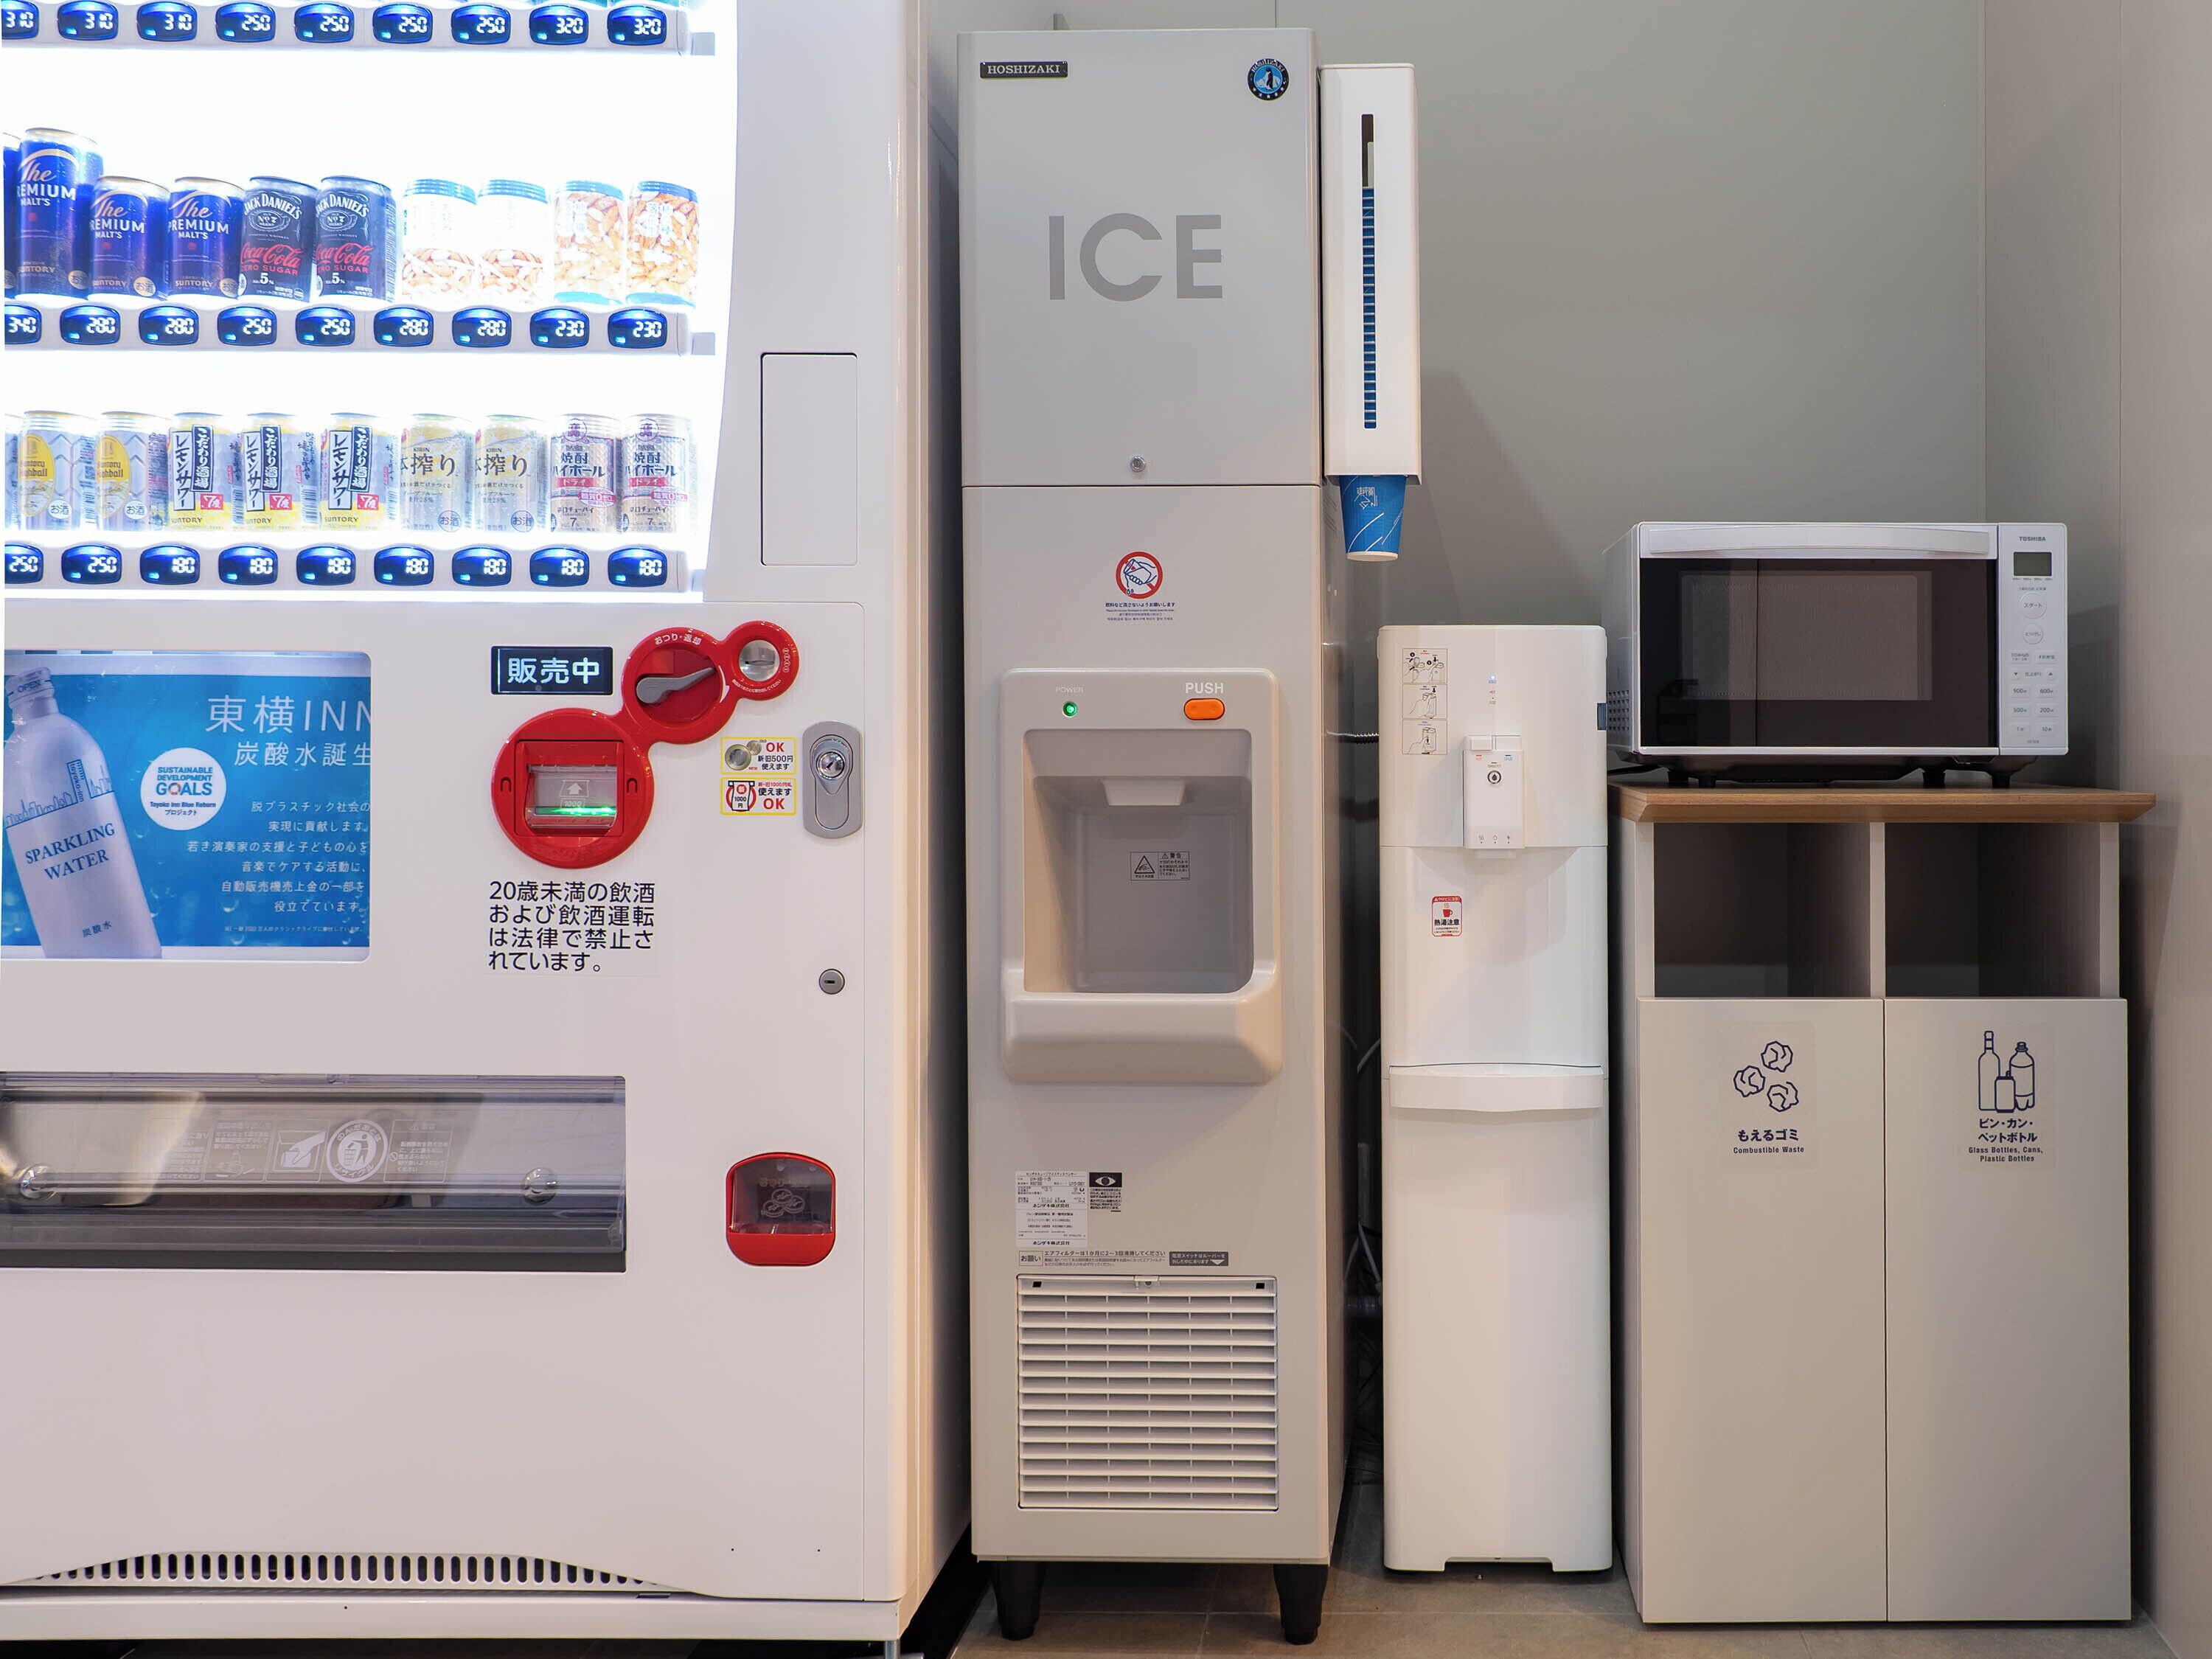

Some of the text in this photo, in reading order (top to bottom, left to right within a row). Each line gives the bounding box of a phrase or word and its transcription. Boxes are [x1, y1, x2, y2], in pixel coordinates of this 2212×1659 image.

[6, 12, 33, 28] 310
[86, 13, 113, 29] 310
[165, 14, 192, 30] 310
[242, 14, 271, 31] 250
[321, 15, 349, 32] 250
[399, 16, 427, 32] 250
[476, 16, 505, 33] 250
[556, 16, 583, 34] 320
[634, 17, 661, 35] 320
[987, 64, 1061, 74] HOSHIZAKI
[20, 159, 57, 183] The
[94, 198, 128, 218] The
[175, 198, 212, 218] The
[244, 193, 302, 220] JACK DANIEL'S
[330, 193, 369, 218] DANIEL'S
[178, 232, 209, 240] MALT'S
[1049, 212, 1223, 302] ICE
[262, 265, 299, 276] SUGAR
[334, 265, 369, 274] SUGAR
[9, 317, 36, 333] 340
[87, 317, 115, 334] 280
[165, 318, 194, 335] 280
[243, 318, 271, 335] 250
[321, 319, 350, 335] 250
[400, 319, 428, 335] 280
[477, 319, 506, 336] 280
[555, 320, 585, 337] 230
[633, 320, 661, 337] 230
[195, 428, 211, 488] こだわり酒場
[263, 428, 279, 489] こだわり酒場
[352, 428, 369, 488] こだわり酒場
[562, 452, 588, 464] 焼酎
[635, 452, 661, 464] 焼酎
[175, 434, 192, 507] レモンサワー
[246, 435, 262, 507] レモンサワー
[333, 434, 349, 507] レモンサワー
[553, 465, 605, 478] ハイボール
[51, 503, 69, 515] お酒
[126, 503, 145, 515] お酒
[440, 517, 459, 526] お酒
[513, 517, 532, 526] お酒
[9, 556, 38, 572] 250
[87, 557, 116, 574] 250
[172, 557, 195, 574] 180
[250, 557, 273, 574] 180
[327, 557, 351, 574] 180
[406, 557, 428, 574] 180
[484, 558, 507, 575] 180
[561, 559, 584, 575] 180
[639, 559, 662, 576] 180
[655, 633, 702, 645] おつり・返却
[507, 658, 599, 684] 販売中
[18, 680, 41, 693] OPEN
[1185, 682, 1224, 695] PUSH
[234, 740, 371, 766] 炭酸水誕生
[766, 742, 785, 752] OK
[156, 782, 212, 796] GOALS
[758, 787, 792, 796] 使えます
[251, 801, 370, 812] 脱プラスチック社会の
[763, 798, 785, 810] OK
[268, 821, 368, 832] 実現に貢献します。
[25, 822, 116, 864] SPARKLING
[187, 841, 367, 854] 若き演奏家の支援と子どもの心を
[44, 849, 109, 880] WATER
[242, 861, 366, 873] 音楽でケアする活動に、
[222, 880, 364, 892] 自動販売機売上金の一部を
[489, 880, 655, 903] 20歳未満の飲酒
[274, 901, 365, 913] 役立てています。
[490, 904, 655, 927] および飲酒運転
[83, 921, 112, 938] 炭酸水
[490, 927, 653, 950] は法律で禁止さ
[488, 950, 601, 973] れています。
[337, 1121, 382, 1141] のんだあとは
[1979, 1119, 2033, 1129] ビン・カン・
[1738, 1129, 1798, 1141] もえるゴミ
[1978, 1132, 2037, 1143] ペットボトル
